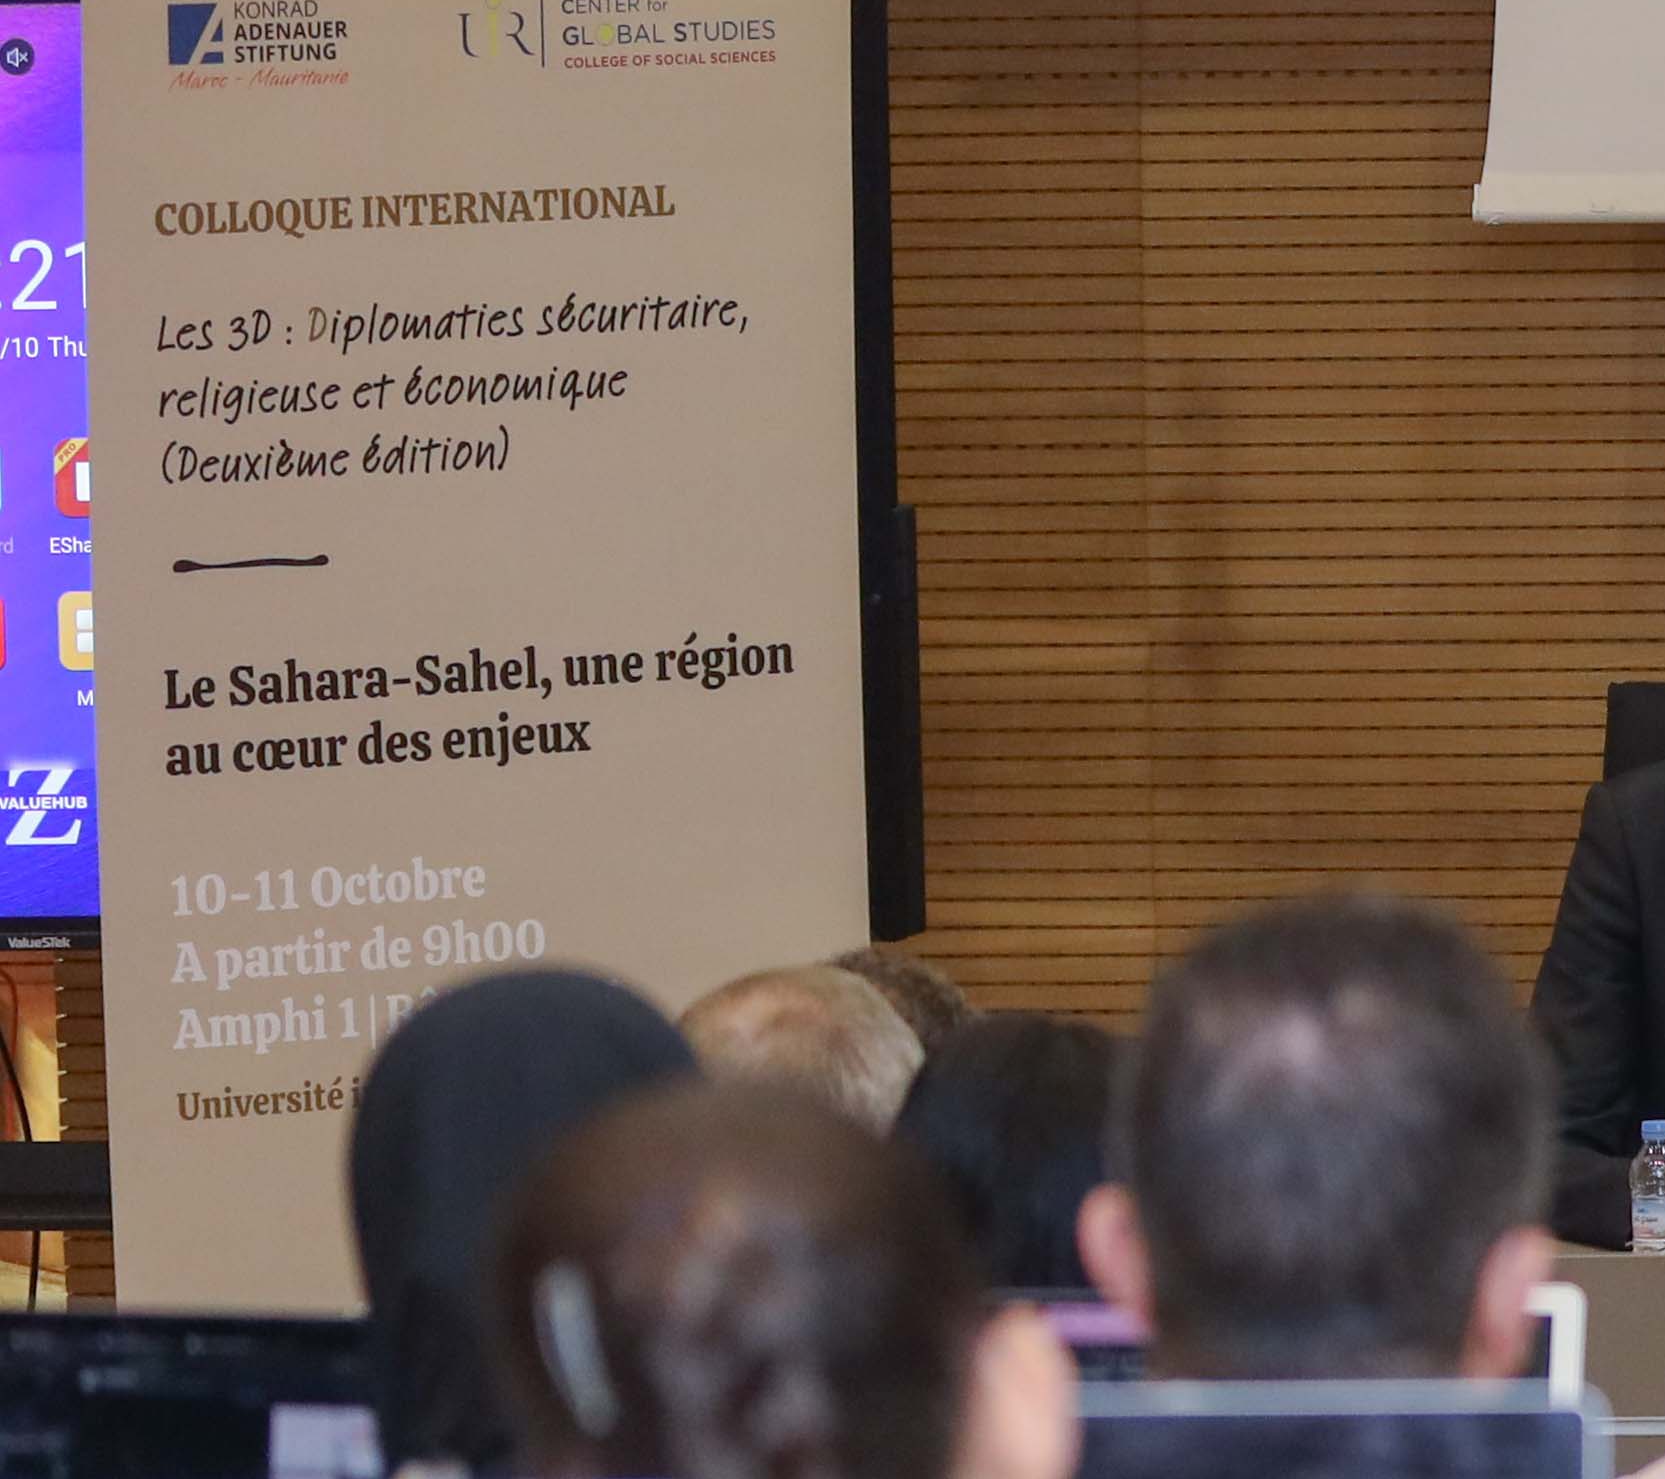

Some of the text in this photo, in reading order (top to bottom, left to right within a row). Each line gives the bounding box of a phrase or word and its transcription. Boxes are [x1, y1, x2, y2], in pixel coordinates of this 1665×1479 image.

[234, 0, 318, 19] KONRAD
[235, 21, 347, 44] ADENAUER
[674, 20, 775, 43] STUDIES
[235, 43, 336, 63] STIFTUNG
[250, 67, 349, 86] Mauritanie
[564, 51, 776, 68] COLLEGE OF SOCIAL SCIENCES
[155, 185, 675, 238] COLLOQUE INTERNATIONAL
[157, 294, 747, 353] Les 3D Diplomaties sécuritaire,
[160, 367, 628, 423] religieuse et économique
[162, 425, 508, 484] (Deuxième édition)
[164, 633, 794, 709] Le Sahara-Sahel, une région
[166, 713, 591, 776] au cœur des enjeux
[171, 858, 485, 916] 10-11 Octobre
[171, 919, 545, 988] A partir de 9h00
[173, 995, 327, 1050] Amphi
[177, 1077, 343, 1120] Université
